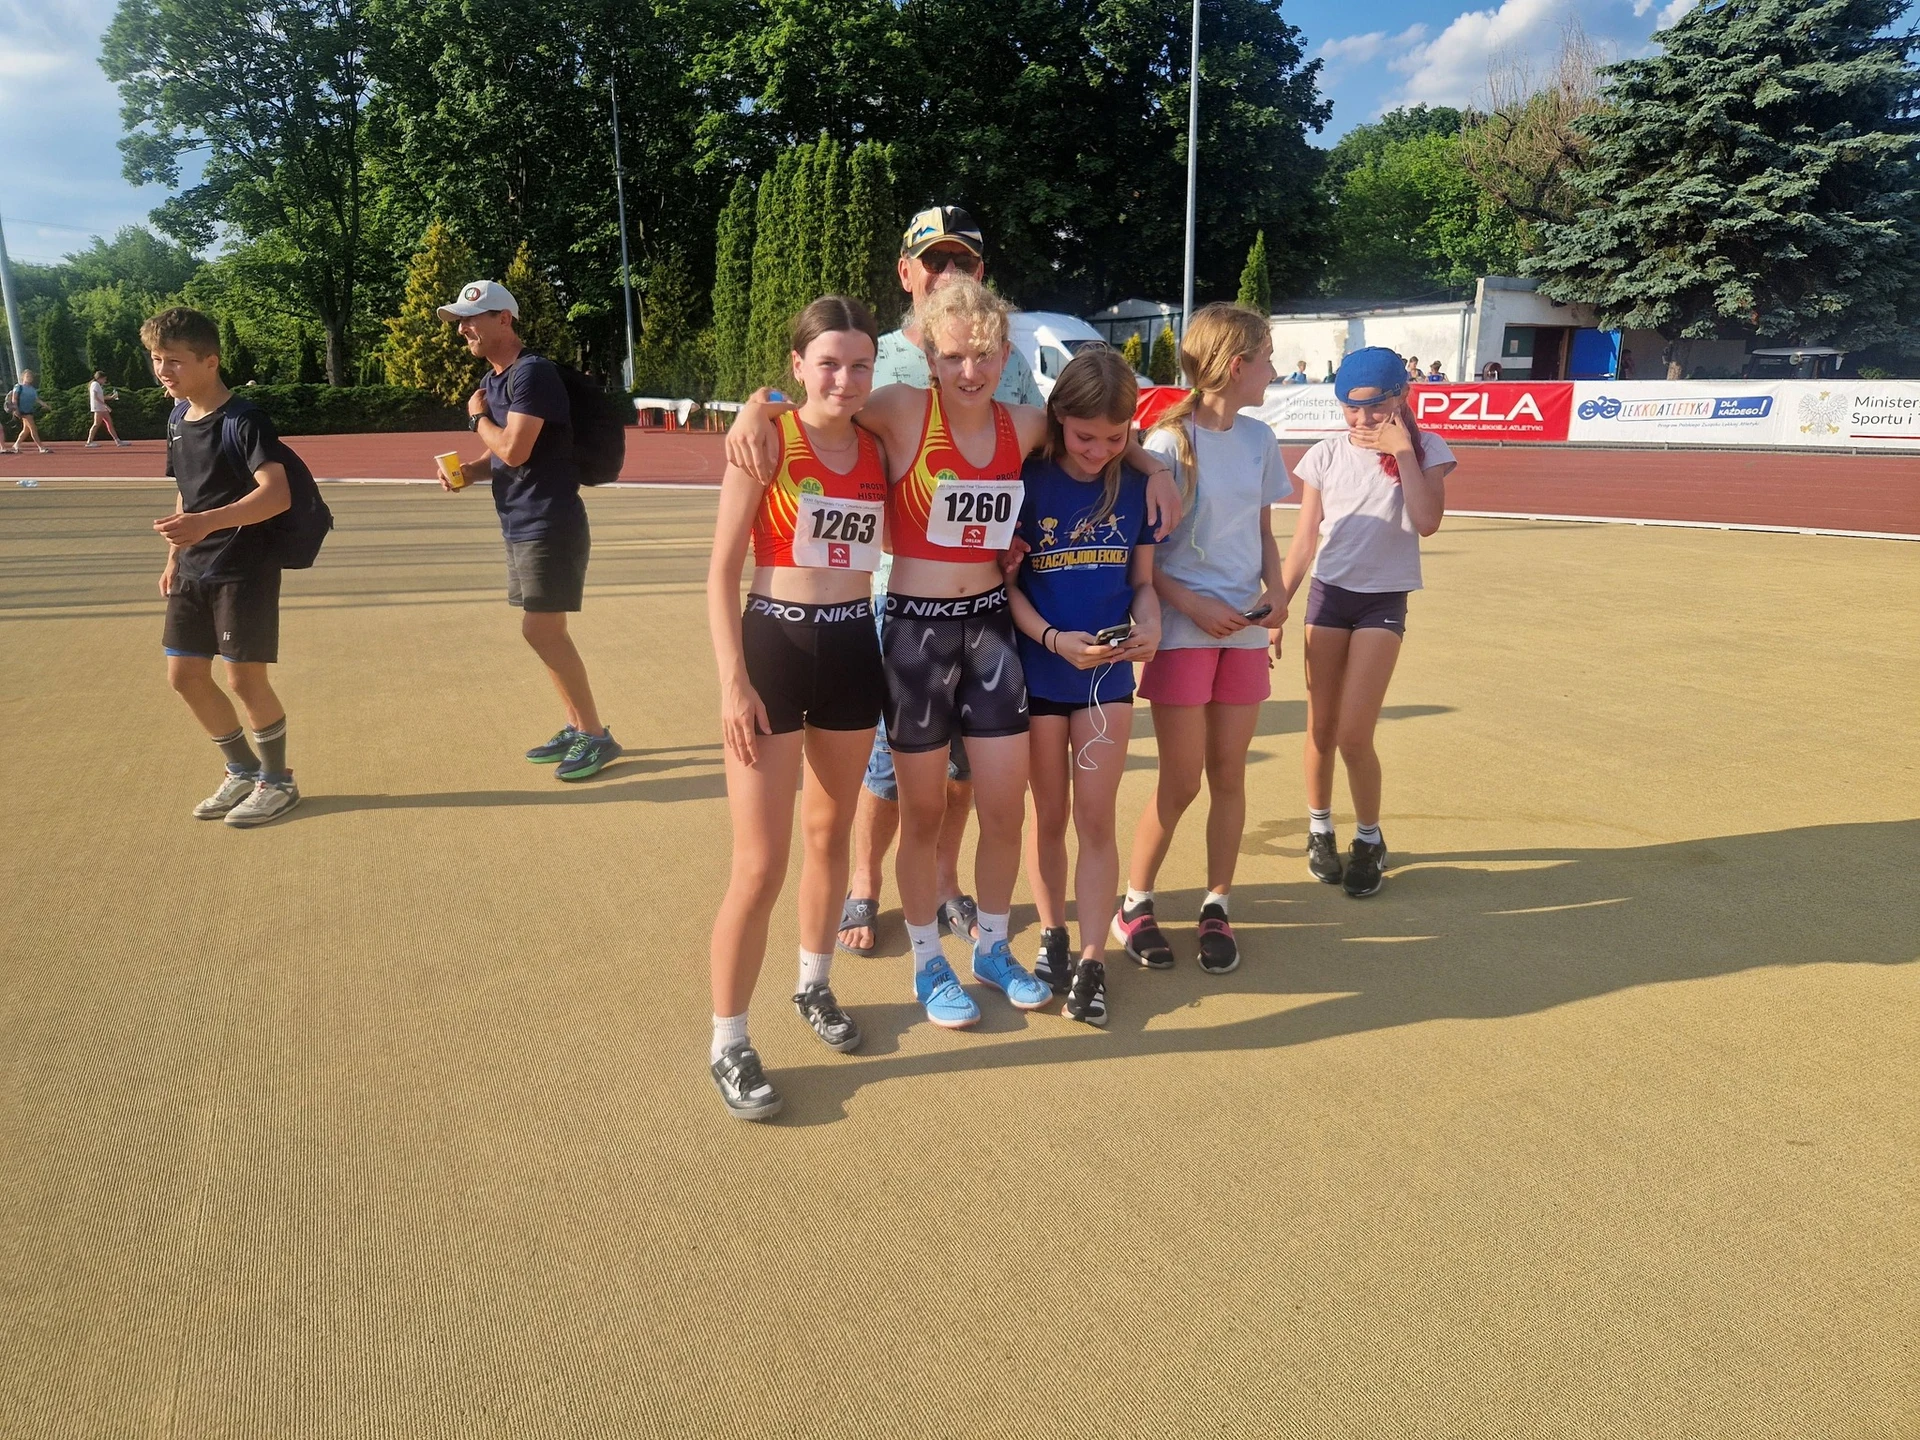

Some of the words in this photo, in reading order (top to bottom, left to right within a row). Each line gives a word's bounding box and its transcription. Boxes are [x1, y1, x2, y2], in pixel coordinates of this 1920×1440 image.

[1417, 392, 1544, 421] PZLA
[1622, 402, 1710, 418] LEKKOATLETYKA
[1720, 400, 1738, 408] DLA
[1855, 396, 1920, 408] Minister
[1285, 411, 1318, 421] Sportu
[1322, 411, 1325, 420] i
[1851, 412, 1903, 426] Sportu
[1908, 413, 1912, 425] i
[944, 492, 1012, 523] 1260
[812, 508, 877, 544] 1263
[750, 598, 806, 622] PRO
[814, 603, 868, 623] NIKE
[903, 600, 970, 617] NIKE
